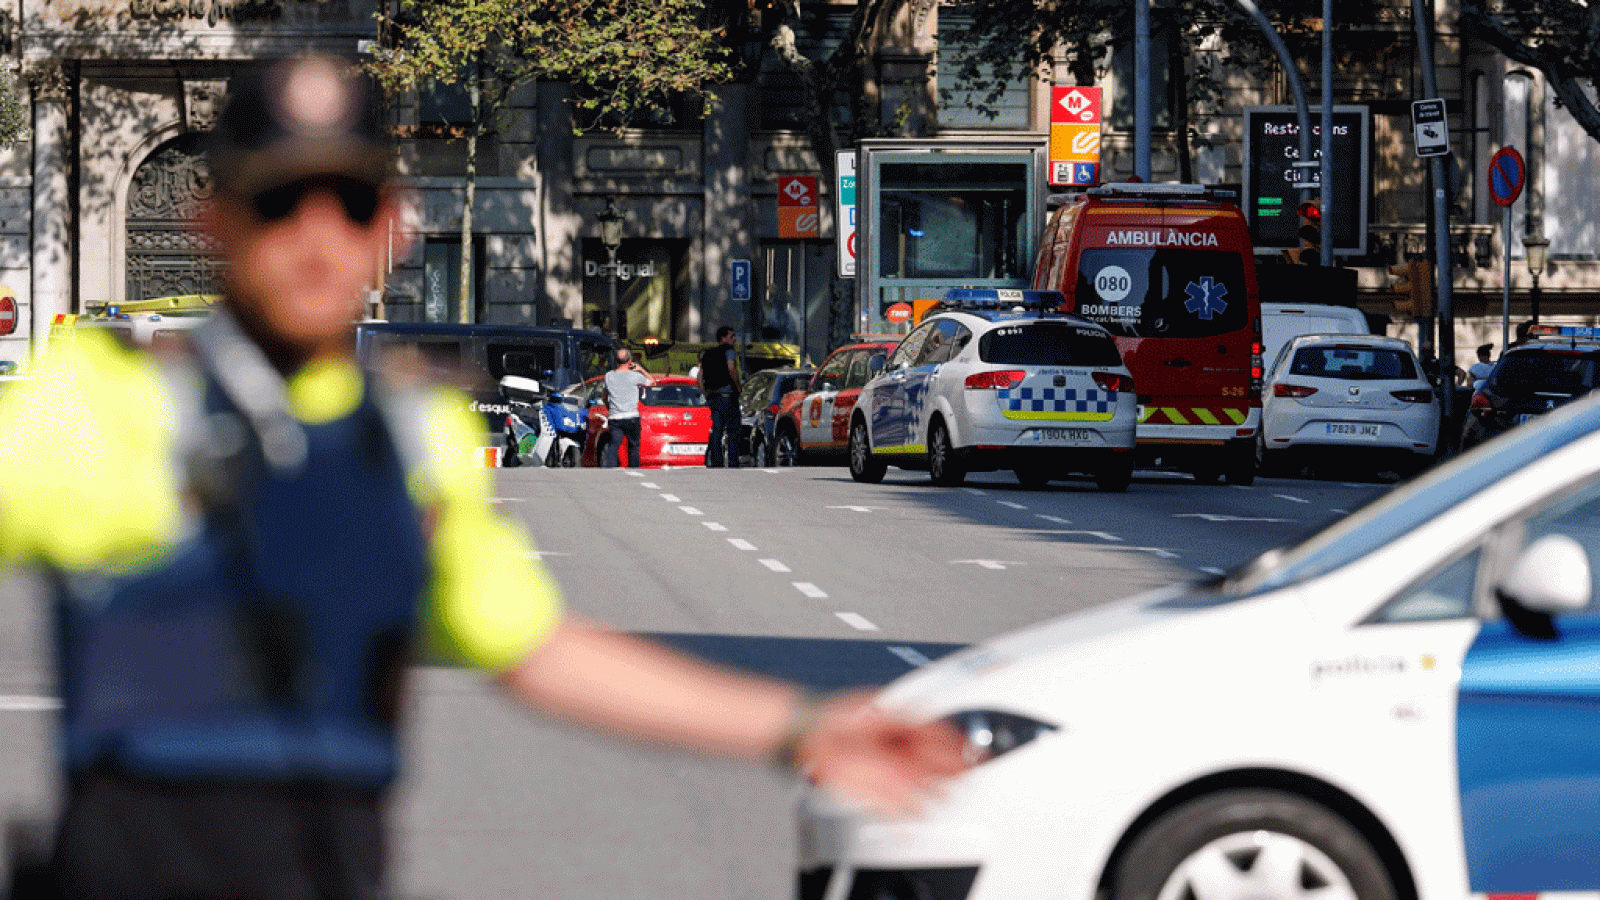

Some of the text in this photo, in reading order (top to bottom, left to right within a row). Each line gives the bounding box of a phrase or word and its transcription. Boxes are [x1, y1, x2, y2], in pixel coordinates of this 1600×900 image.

[1068, 96, 1082, 109] M
[1264, 122, 1348, 135] Restrcns
[1106, 228, 1219, 247] AMBULÀNCIA
[735, 266, 745, 281] P
[1098, 276, 1129, 291] 080
[1081, 304, 1142, 317] BOMBERS
